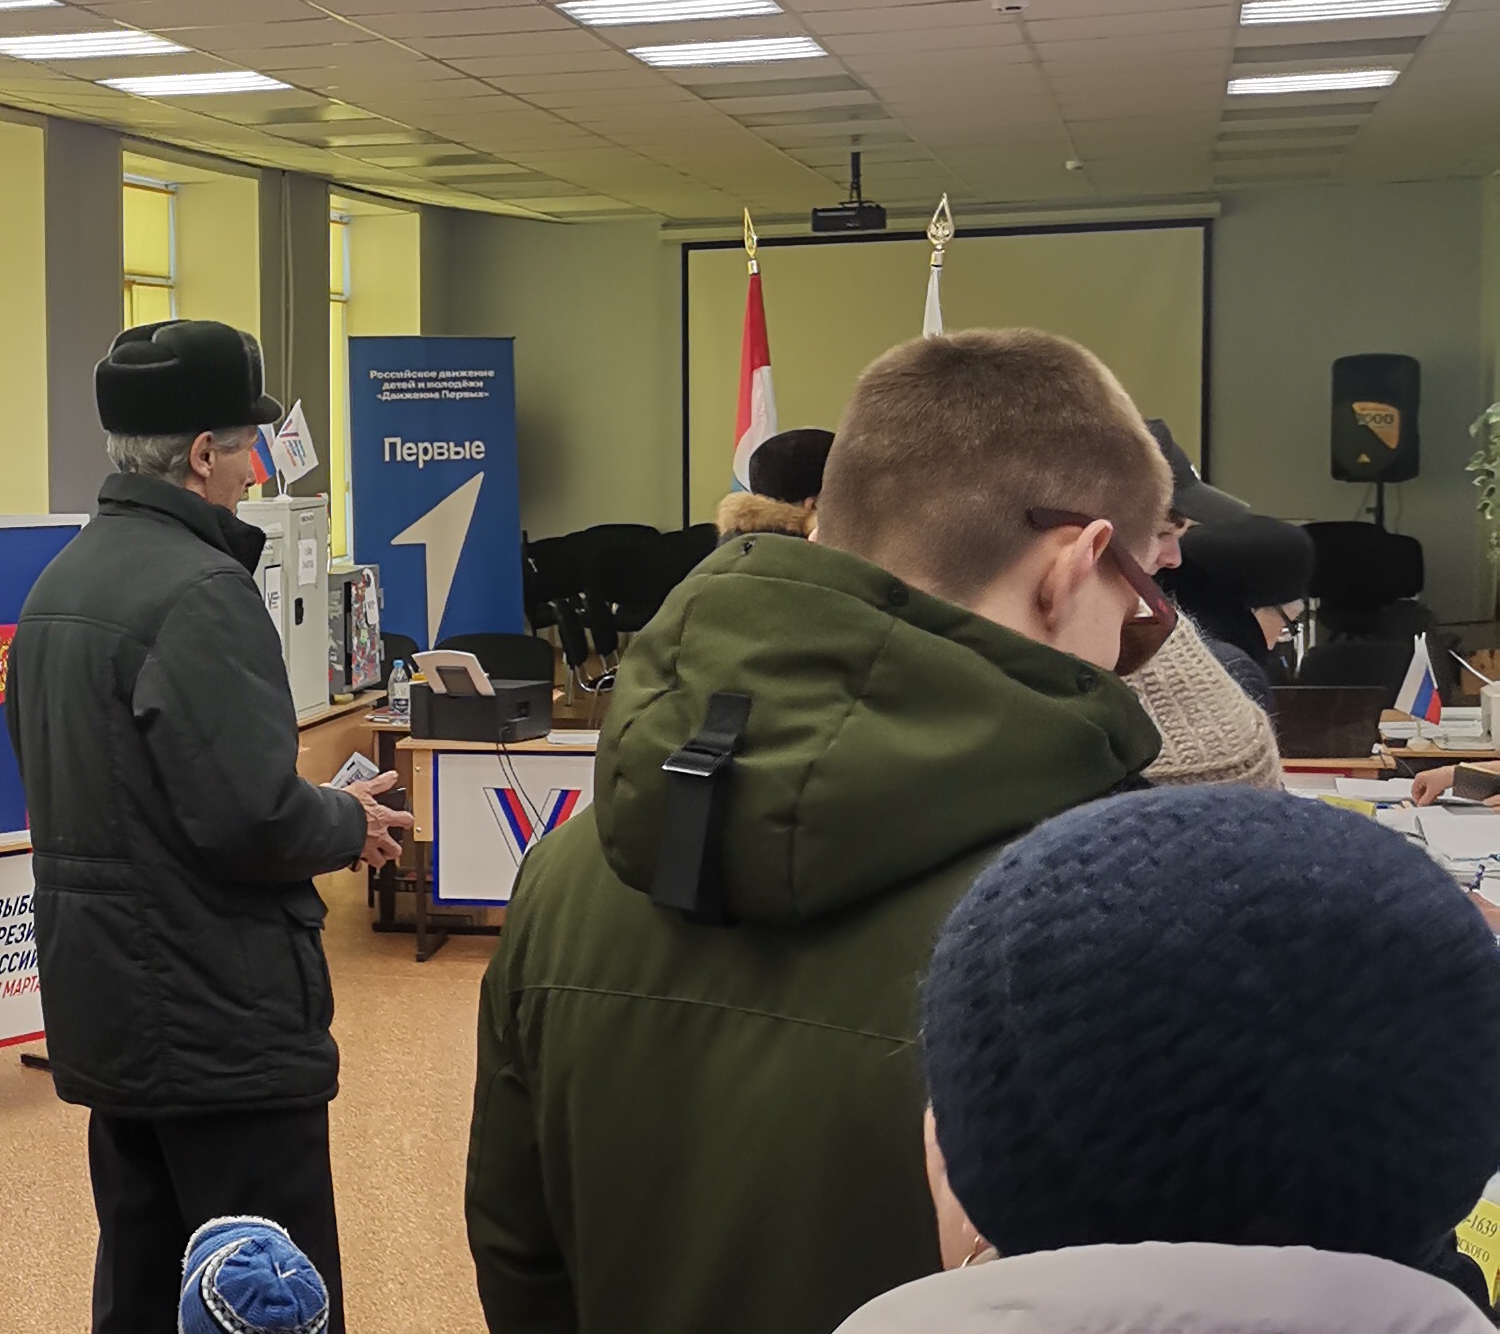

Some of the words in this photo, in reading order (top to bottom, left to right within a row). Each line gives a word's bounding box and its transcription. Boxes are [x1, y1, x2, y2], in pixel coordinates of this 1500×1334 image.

[369, 370, 437, 379] Российское
[438, 370, 495, 379] движение
[383, 436, 486, 469] Первые
